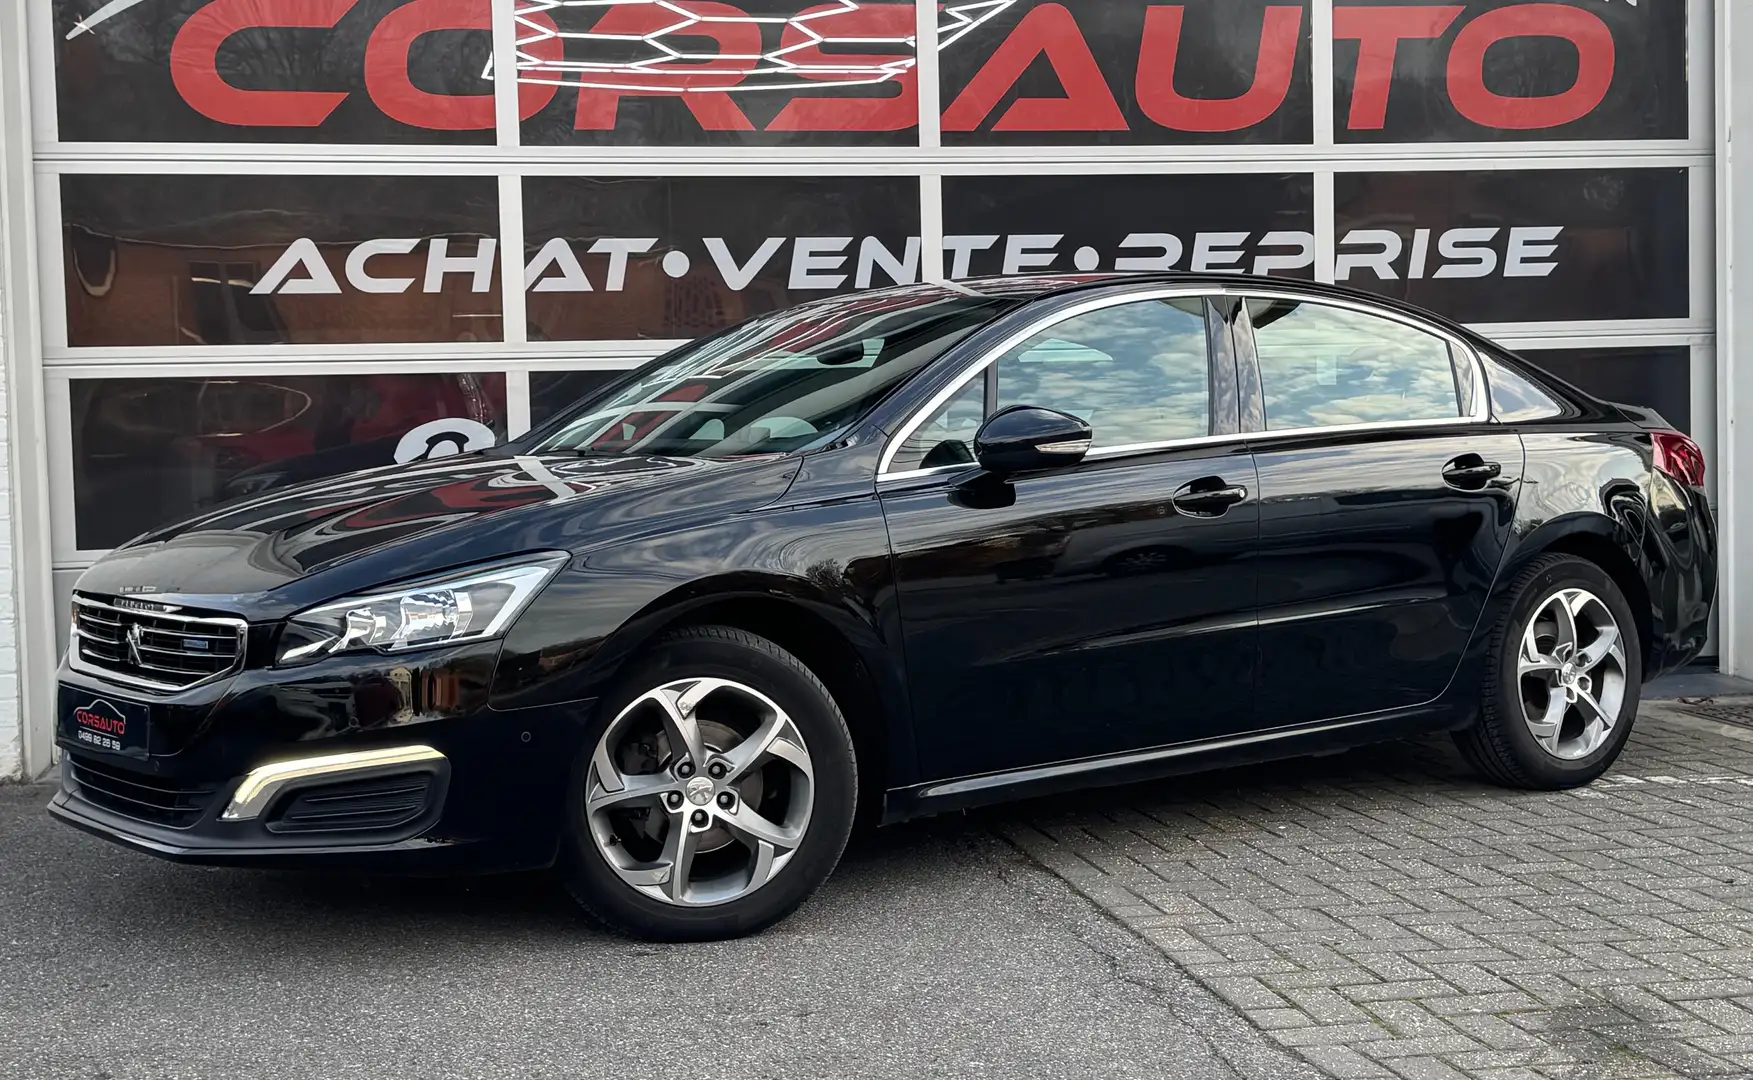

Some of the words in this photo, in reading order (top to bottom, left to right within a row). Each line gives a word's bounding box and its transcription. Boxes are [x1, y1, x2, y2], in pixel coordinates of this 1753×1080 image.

[170, 0, 1616, 132] CORSAUTO
[249, 237, 659, 294] ACHAT
[702, 233, 1064, 290] VENTE
[1114, 226, 1564, 280] REPRISE
[76, 709, 126, 736] CORSAUTO
